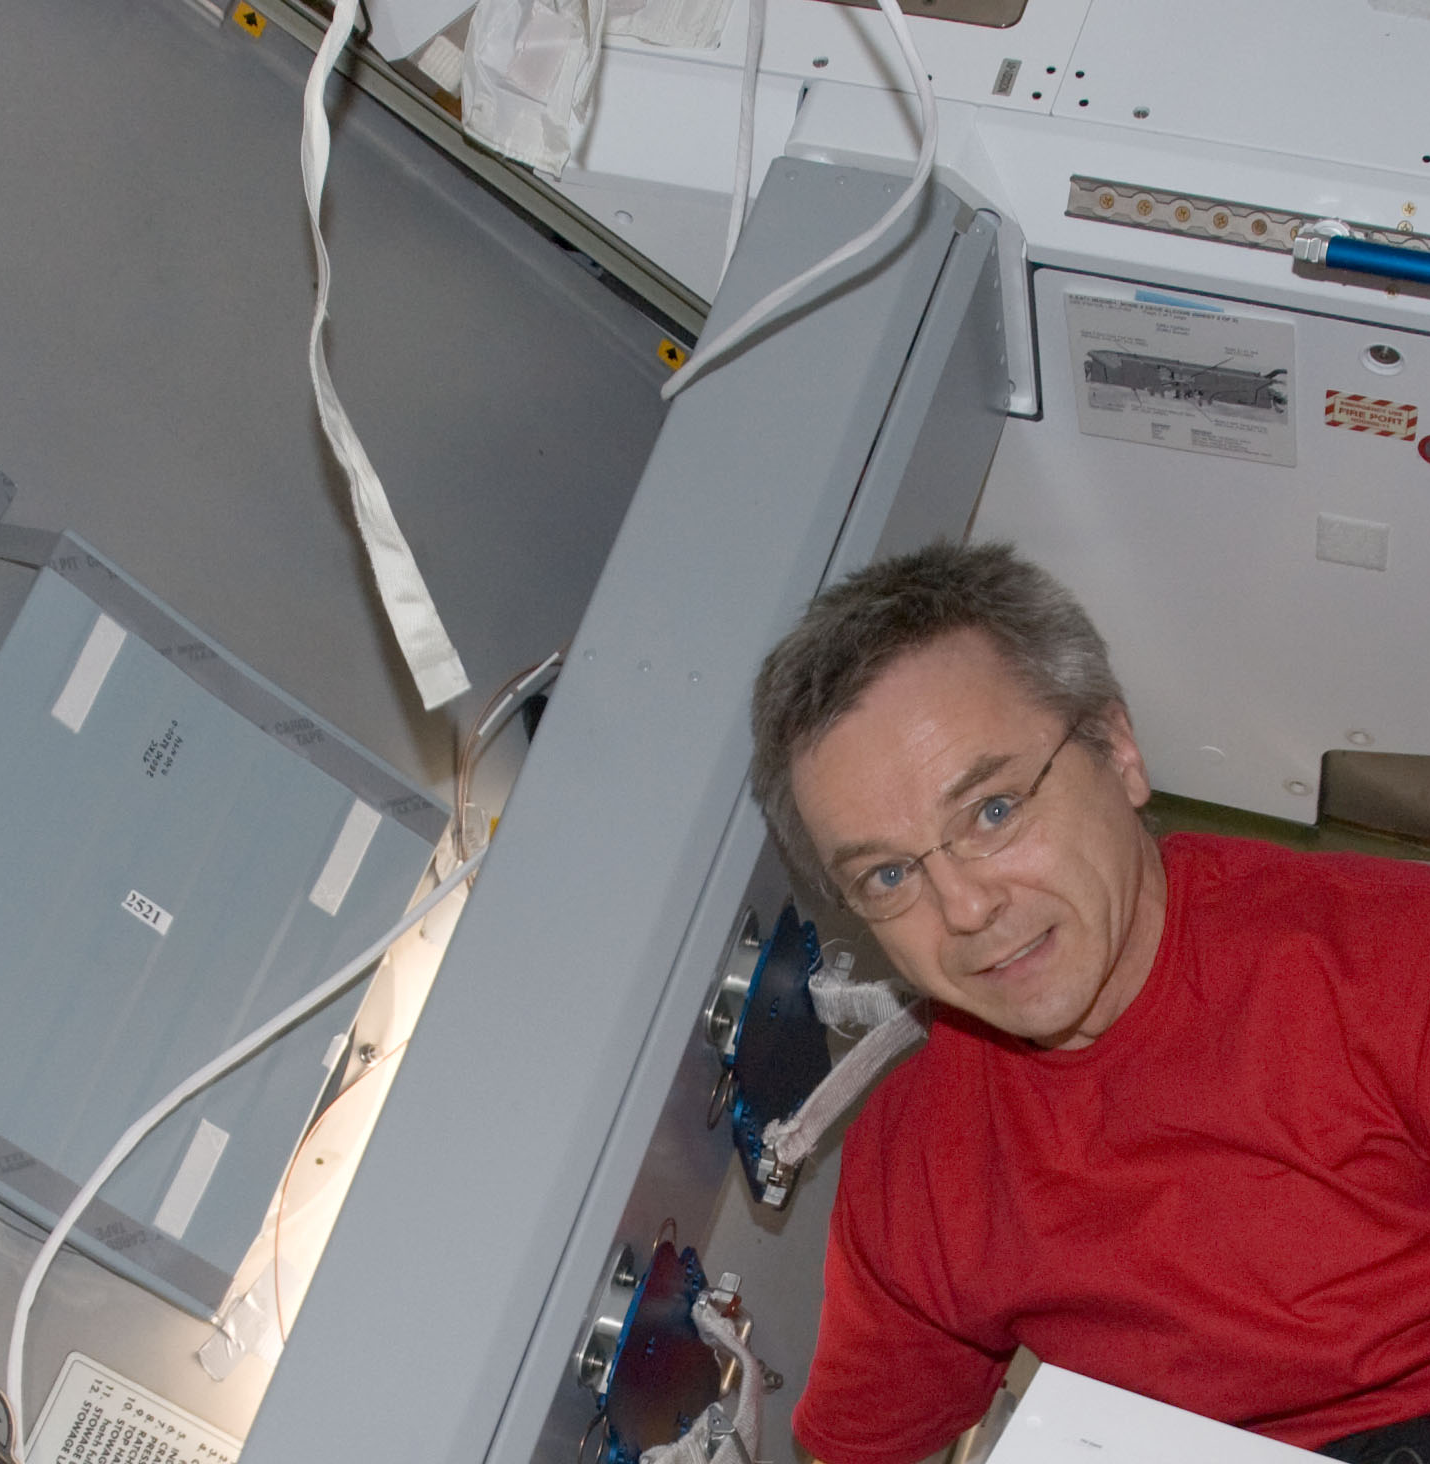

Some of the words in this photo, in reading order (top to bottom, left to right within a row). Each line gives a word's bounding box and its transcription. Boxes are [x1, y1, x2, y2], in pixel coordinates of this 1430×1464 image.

[1338, 407, 1366, 418] FIRE
[1368, 413, 1403, 426] PORT
[125, 893, 161, 924] 2521
[60, 1399, 92, 1453] STOWAGE
[71, 1405, 103, 1459] STOWAGE
[90, 1417, 111, 1449] hatch
[118, 1423, 136, 1446] TOP
